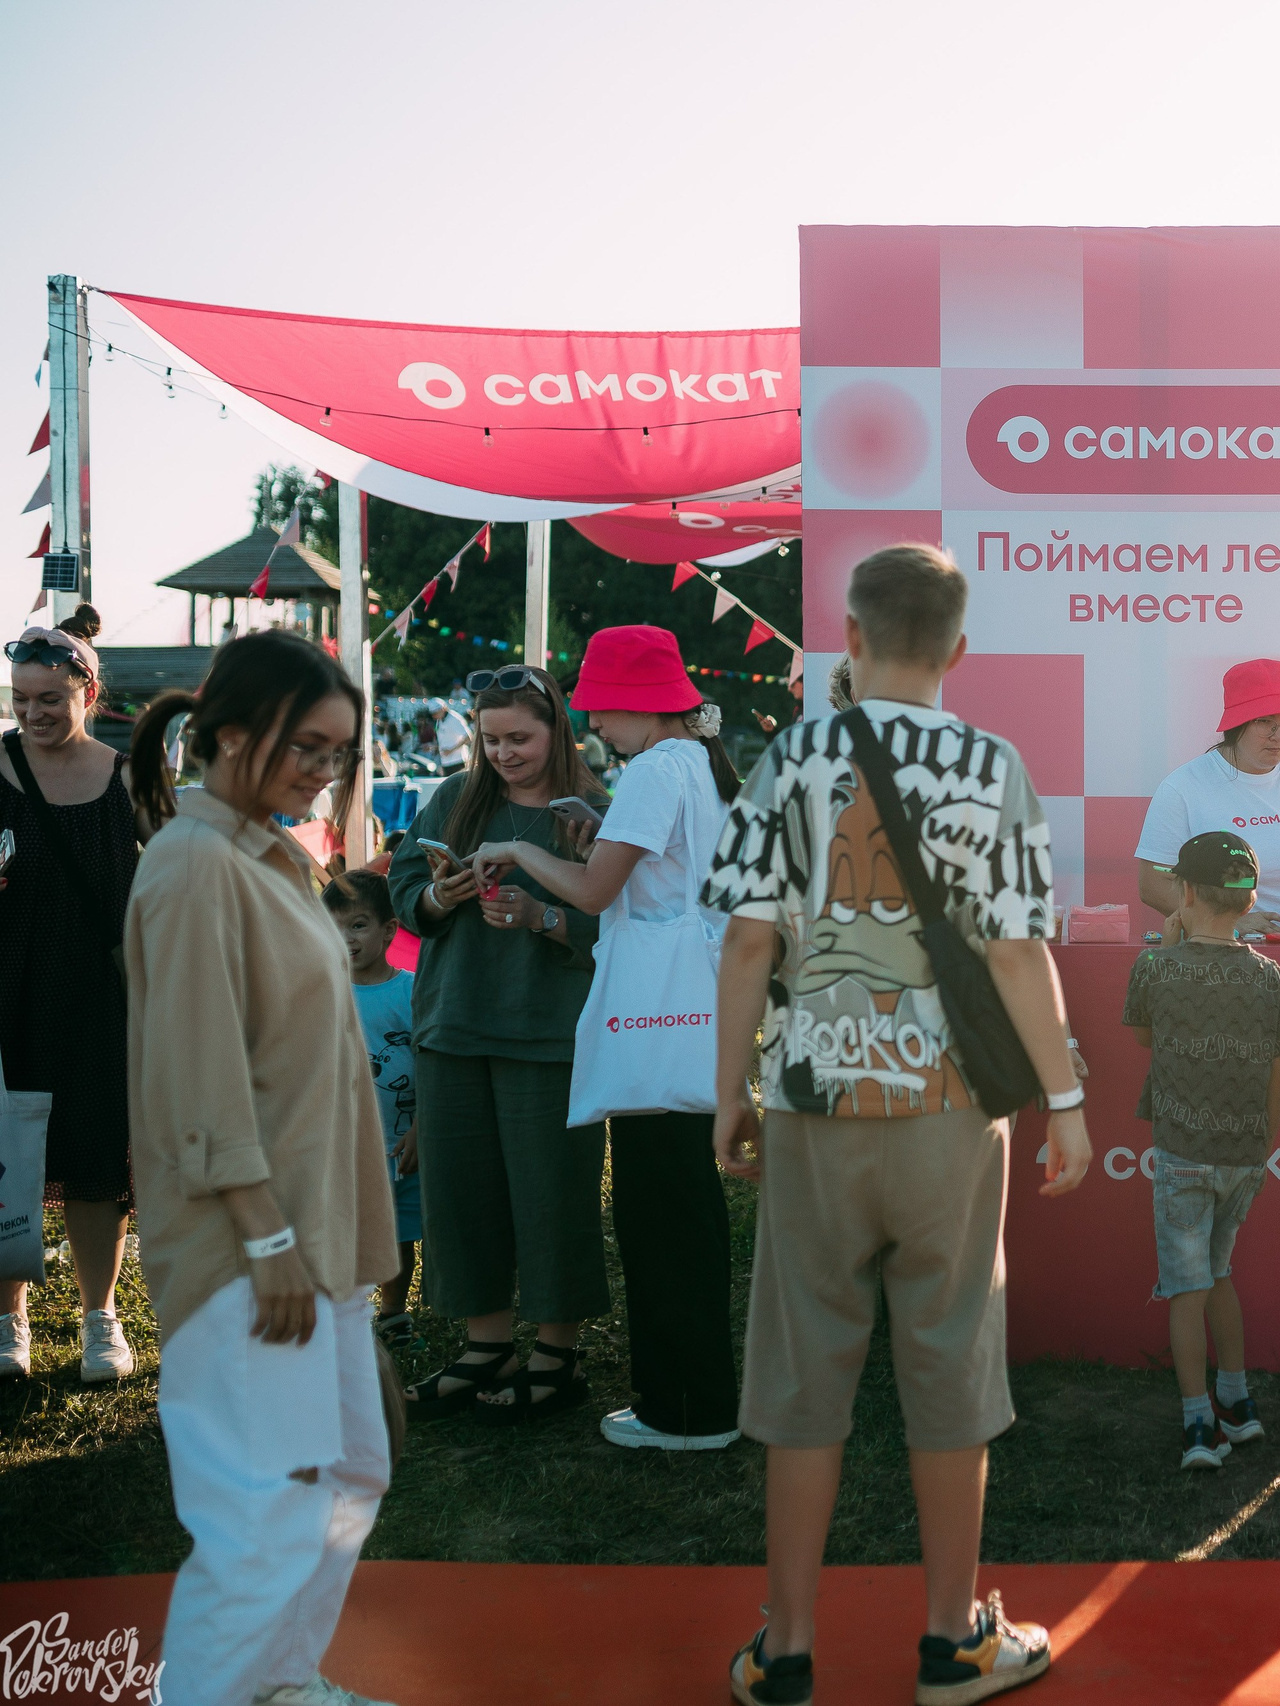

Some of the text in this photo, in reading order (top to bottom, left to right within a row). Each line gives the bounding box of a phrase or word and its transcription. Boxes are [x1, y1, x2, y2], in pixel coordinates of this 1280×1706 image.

[483, 368, 783, 406] самокат
[977, 529, 1208, 573] Поймаем
[1069, 593, 1244, 623] вместе
[623, 1013, 712, 1030] самокат
